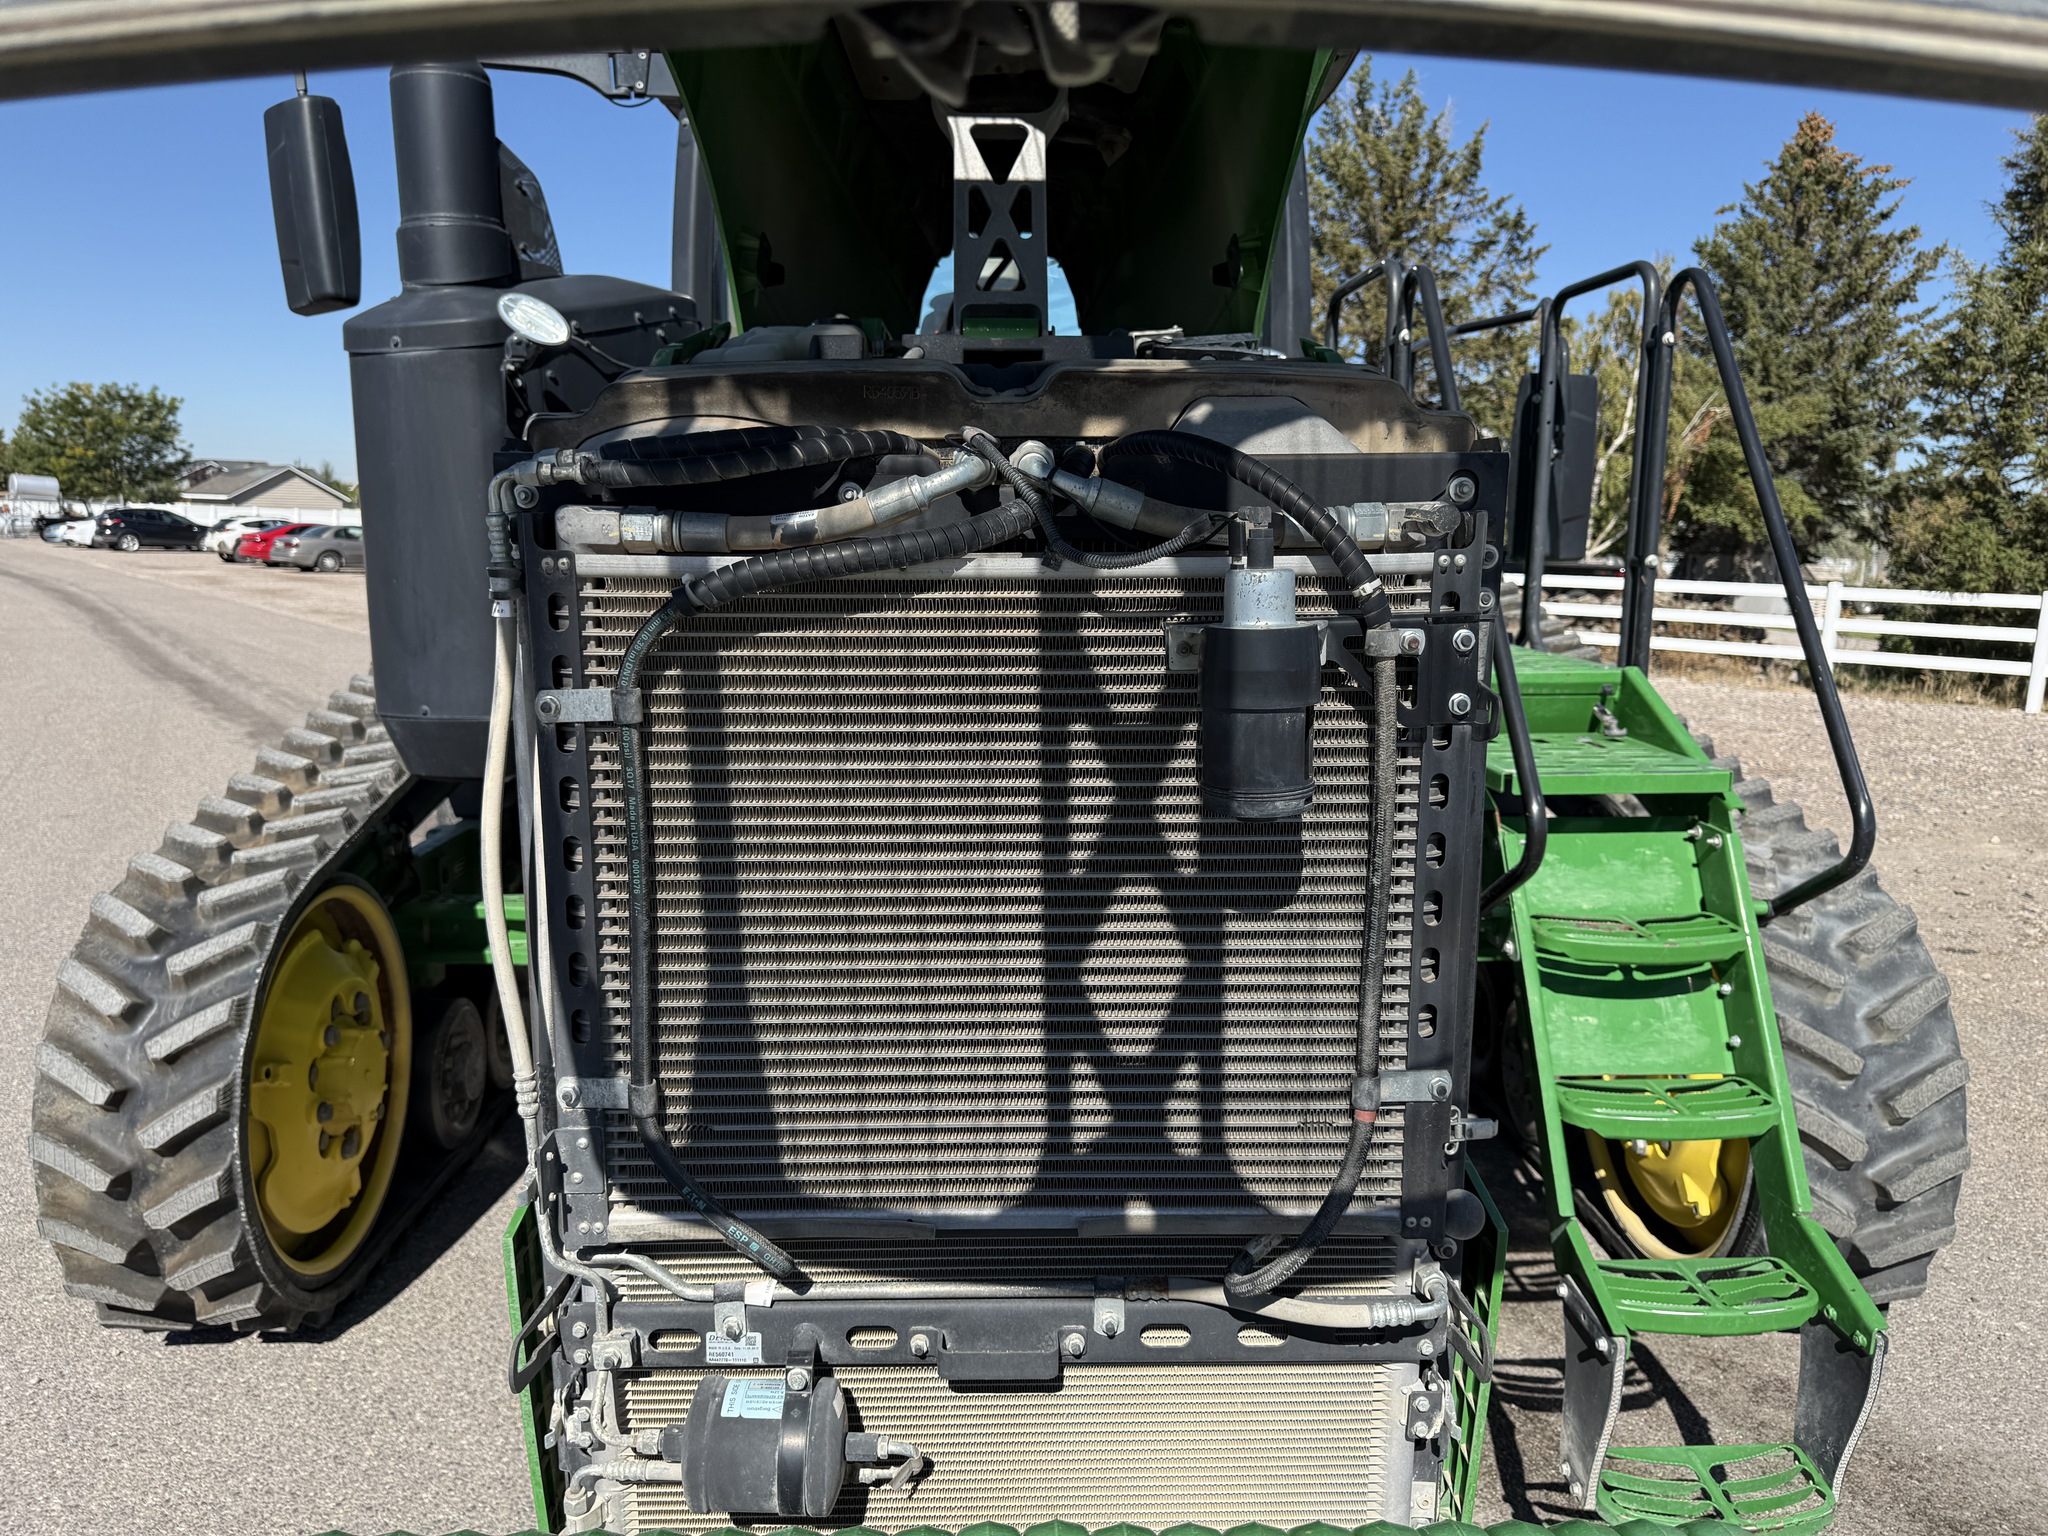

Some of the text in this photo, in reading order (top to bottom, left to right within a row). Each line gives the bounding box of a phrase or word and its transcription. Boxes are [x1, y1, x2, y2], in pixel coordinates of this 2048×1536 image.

[647, 618, 662, 632] mm
[620, 661, 633, 687] DN10
[626, 766, 635, 789] 3Q17
[628, 796, 637, 821] Made
[630, 822, 637, 830] in
[631, 830, 639, 851] USA
[727, 1225, 749, 1243] ESP
[727, 1397, 736, 1413] THIS
